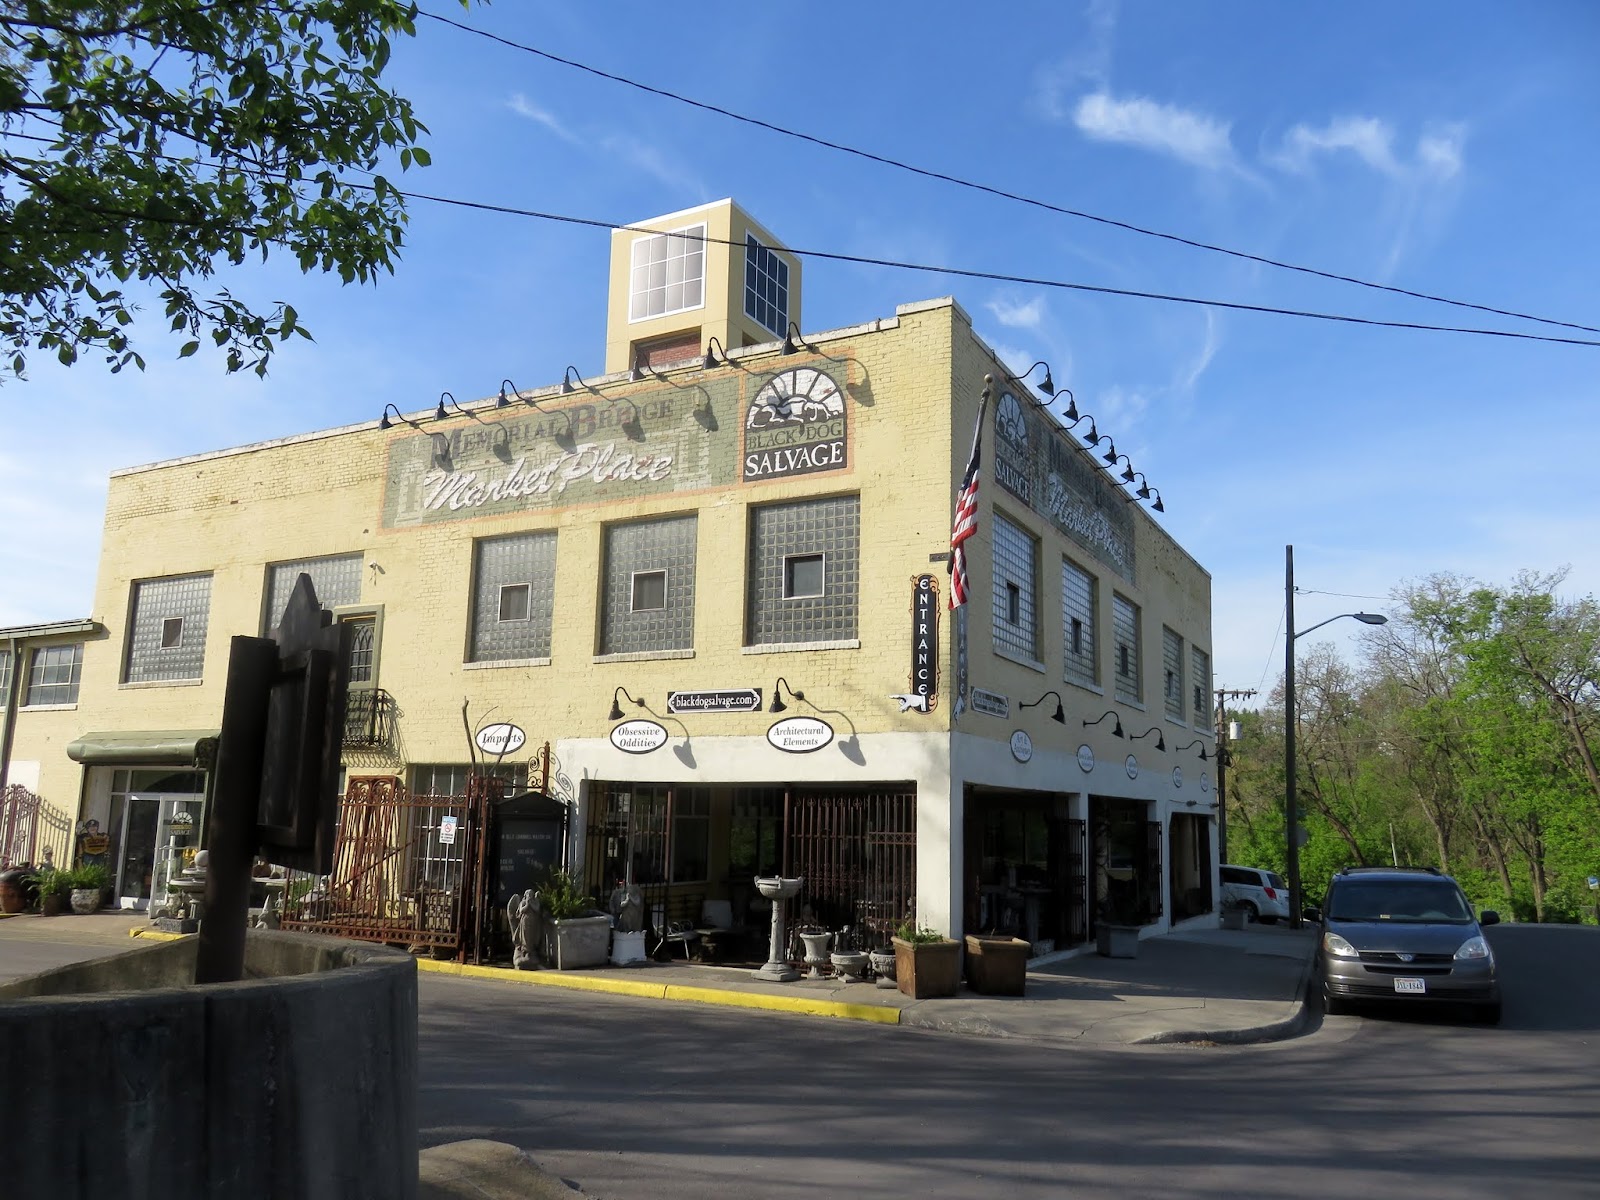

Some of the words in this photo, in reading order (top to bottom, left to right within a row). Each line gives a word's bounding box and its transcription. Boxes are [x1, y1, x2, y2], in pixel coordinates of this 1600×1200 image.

[748, 428, 797, 450] BLACK
[806, 422, 842, 440] DOG
[745, 441, 844, 477] SALVAGE
[423, 456, 554, 511] Market
[556, 442, 674, 493] Place
[995, 459, 1029, 502] SALVAGE
[918, 578, 929, 695] ENTRANCE
[675, 694, 753, 709] blackdogsalvage.com
[618, 727, 660, 737] Obsessive
[773, 725, 825, 736] Architectural
[619, 738, 657, 748] Oddities
[782, 737, 819, 747] Elements
